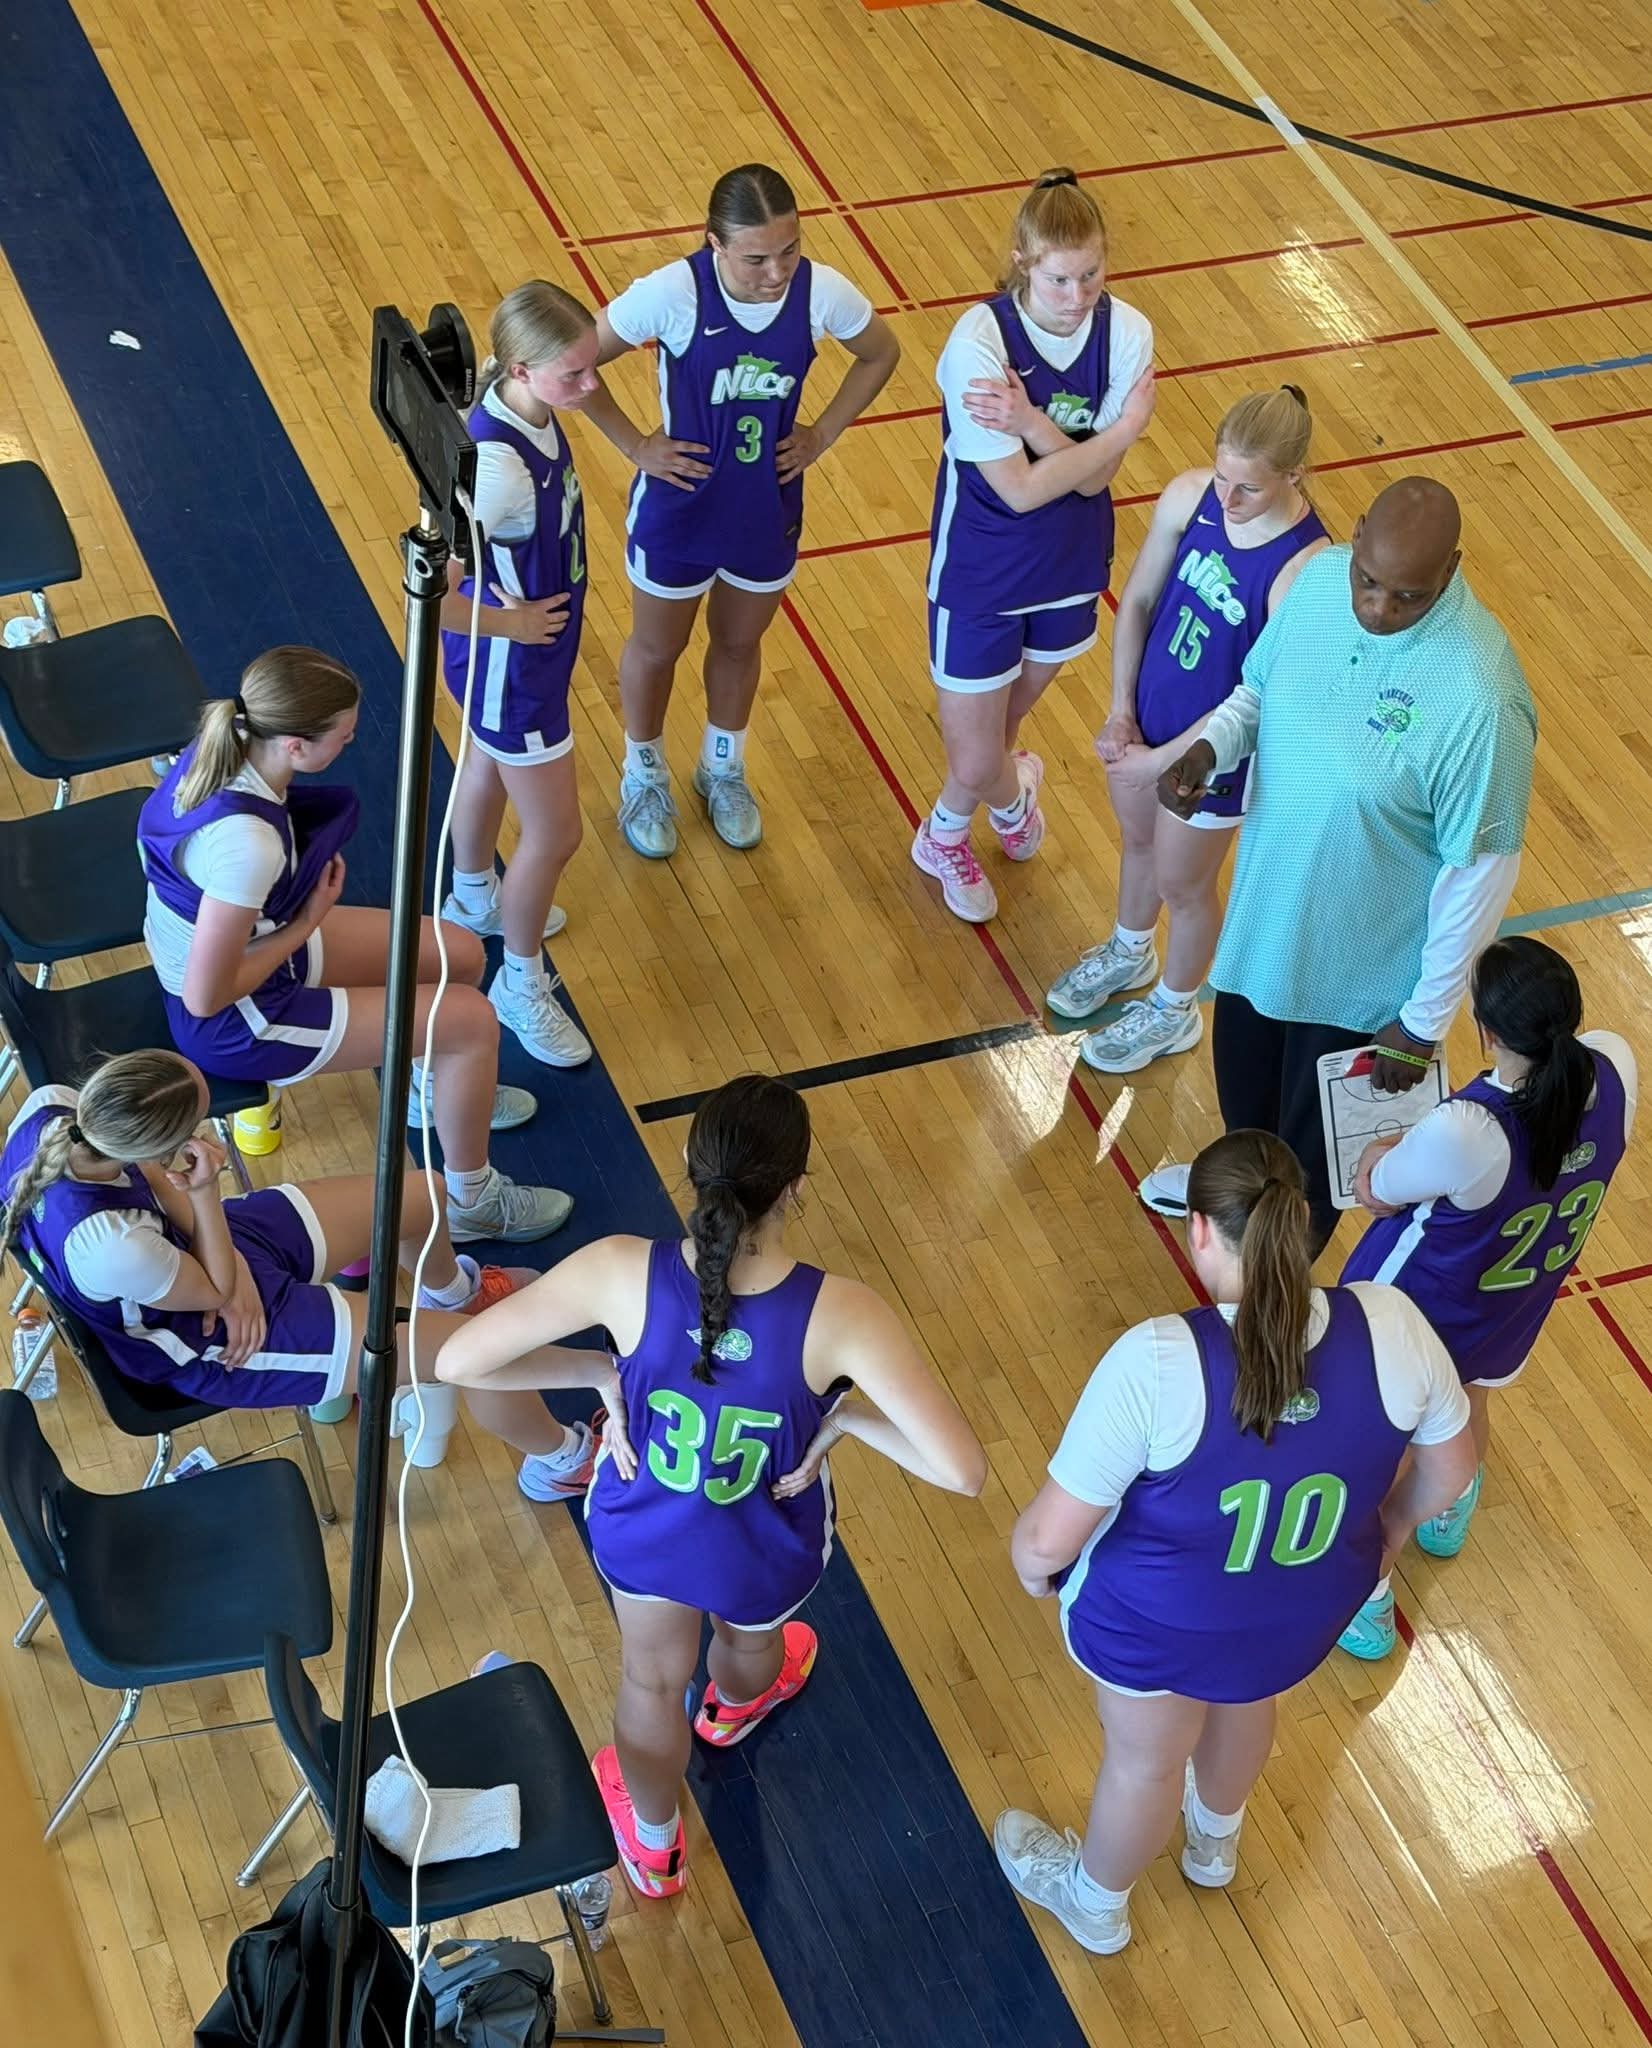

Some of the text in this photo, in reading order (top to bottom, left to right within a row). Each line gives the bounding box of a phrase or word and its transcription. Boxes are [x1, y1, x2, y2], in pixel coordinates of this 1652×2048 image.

[711, 365, 796, 404] Nice
[736, 416, 762, 463] 3
[1178, 549, 1246, 625] Nice
[1168, 606, 1210, 670] 15
[1478, 1180, 1606, 1292] 23
[647, 1389, 783, 1505] 35
[1219, 1473, 1348, 1573] 10
